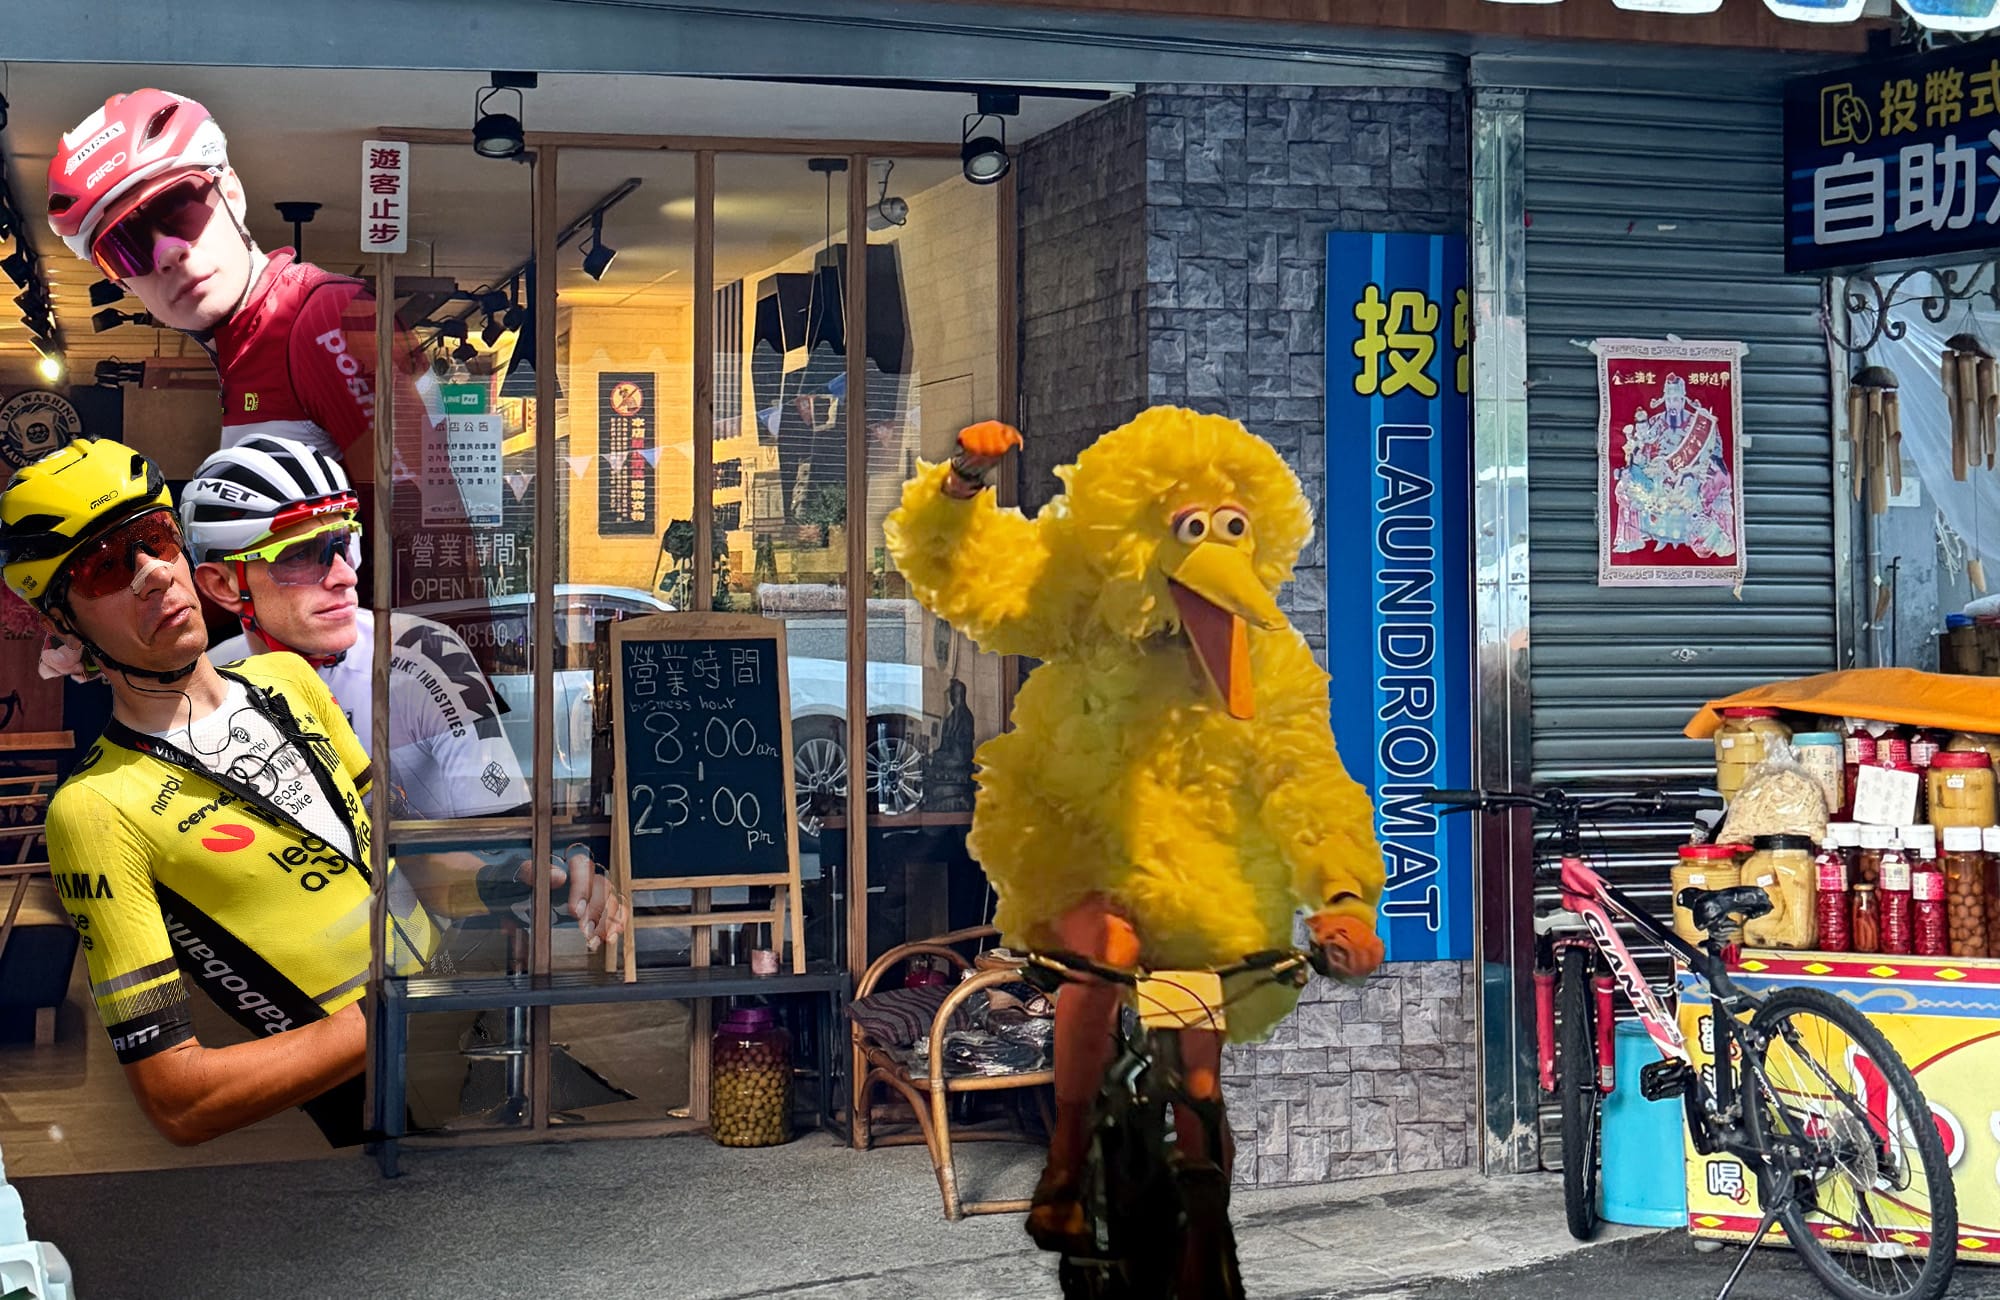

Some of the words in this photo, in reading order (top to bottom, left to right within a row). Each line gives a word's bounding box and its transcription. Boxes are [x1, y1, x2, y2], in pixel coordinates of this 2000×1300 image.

[86, 151, 127, 189] GIRO
[369, 148, 401, 244] 遊客止步
[20, 394, 77, 424] WASHING
[90, 490, 119, 510] GIRO
[197, 480, 258, 503] MET
[312, 503, 346, 516] MET
[411, 533, 515, 568] 營業時間
[411, 577, 464, 600] OPEN
[469, 576, 514, 600] TIME
[628, 643, 760, 696] 營業時間
[1376, 424, 1441, 932] LAUNDROMAT
[391, 656, 418, 675] BIKE
[416, 669, 466, 738] INDUSTRIES
[699, 697, 736, 710] hour
[644, 711, 757, 764] 8:00
[151, 774, 184, 817] nimbl
[273, 779, 303, 806] ease
[632, 784, 761, 836] 23:00
[164, 912, 294, 1036] Rabobank
[1582, 910, 1660, 1023] GIANT
